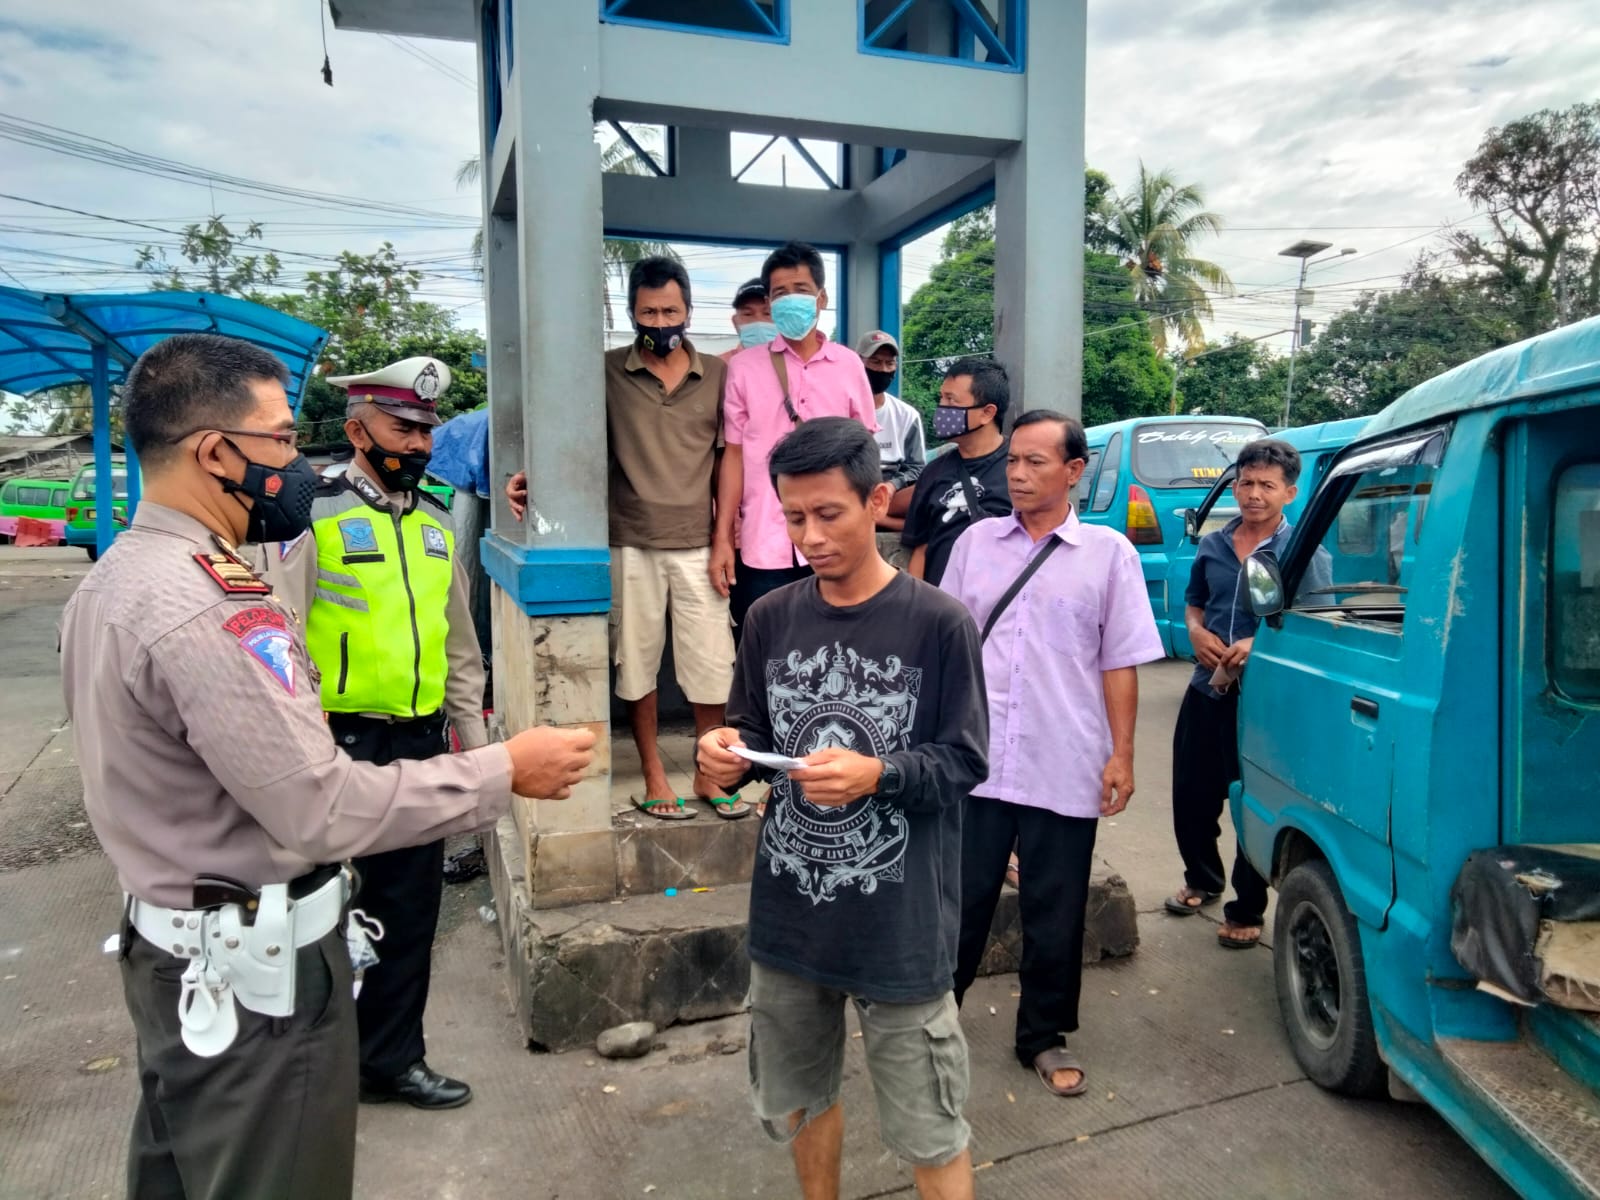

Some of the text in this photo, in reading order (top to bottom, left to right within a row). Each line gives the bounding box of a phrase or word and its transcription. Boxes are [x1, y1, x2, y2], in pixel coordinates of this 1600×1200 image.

[1191, 467, 1226, 478] TUMA
[789, 838, 853, 859] ART OF LIVE
